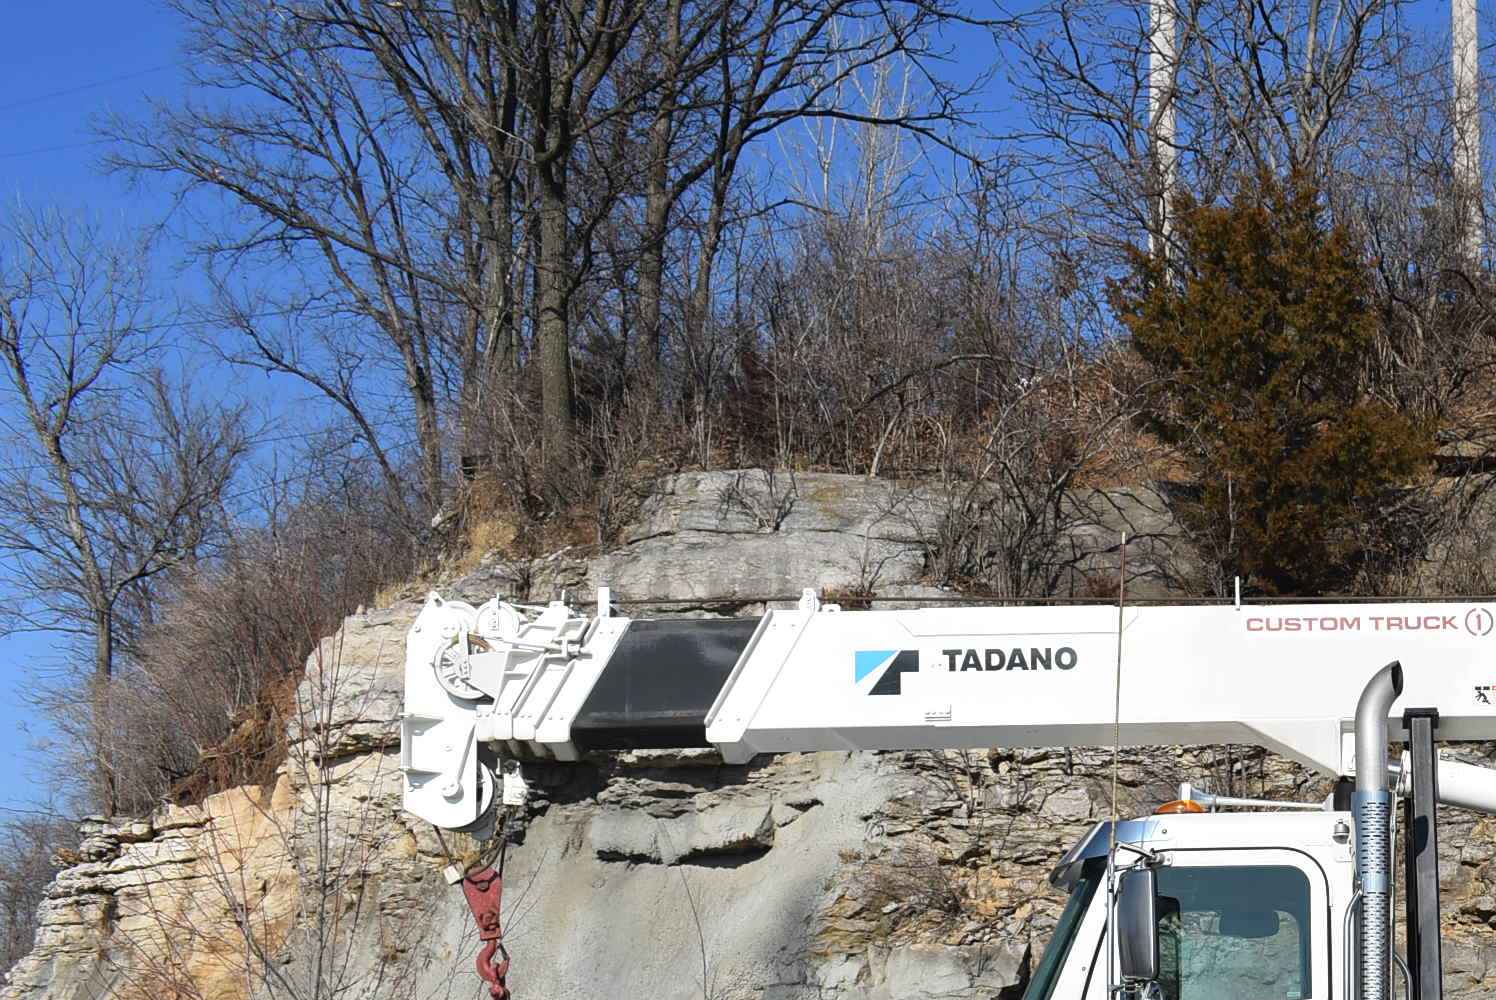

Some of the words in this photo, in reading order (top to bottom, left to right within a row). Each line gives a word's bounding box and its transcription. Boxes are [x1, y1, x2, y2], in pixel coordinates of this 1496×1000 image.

[1246, 616, 1361, 632] CUSTOM
[1369, 615, 1458, 630] TRUCK
[942, 646, 1078, 672] TADANO
